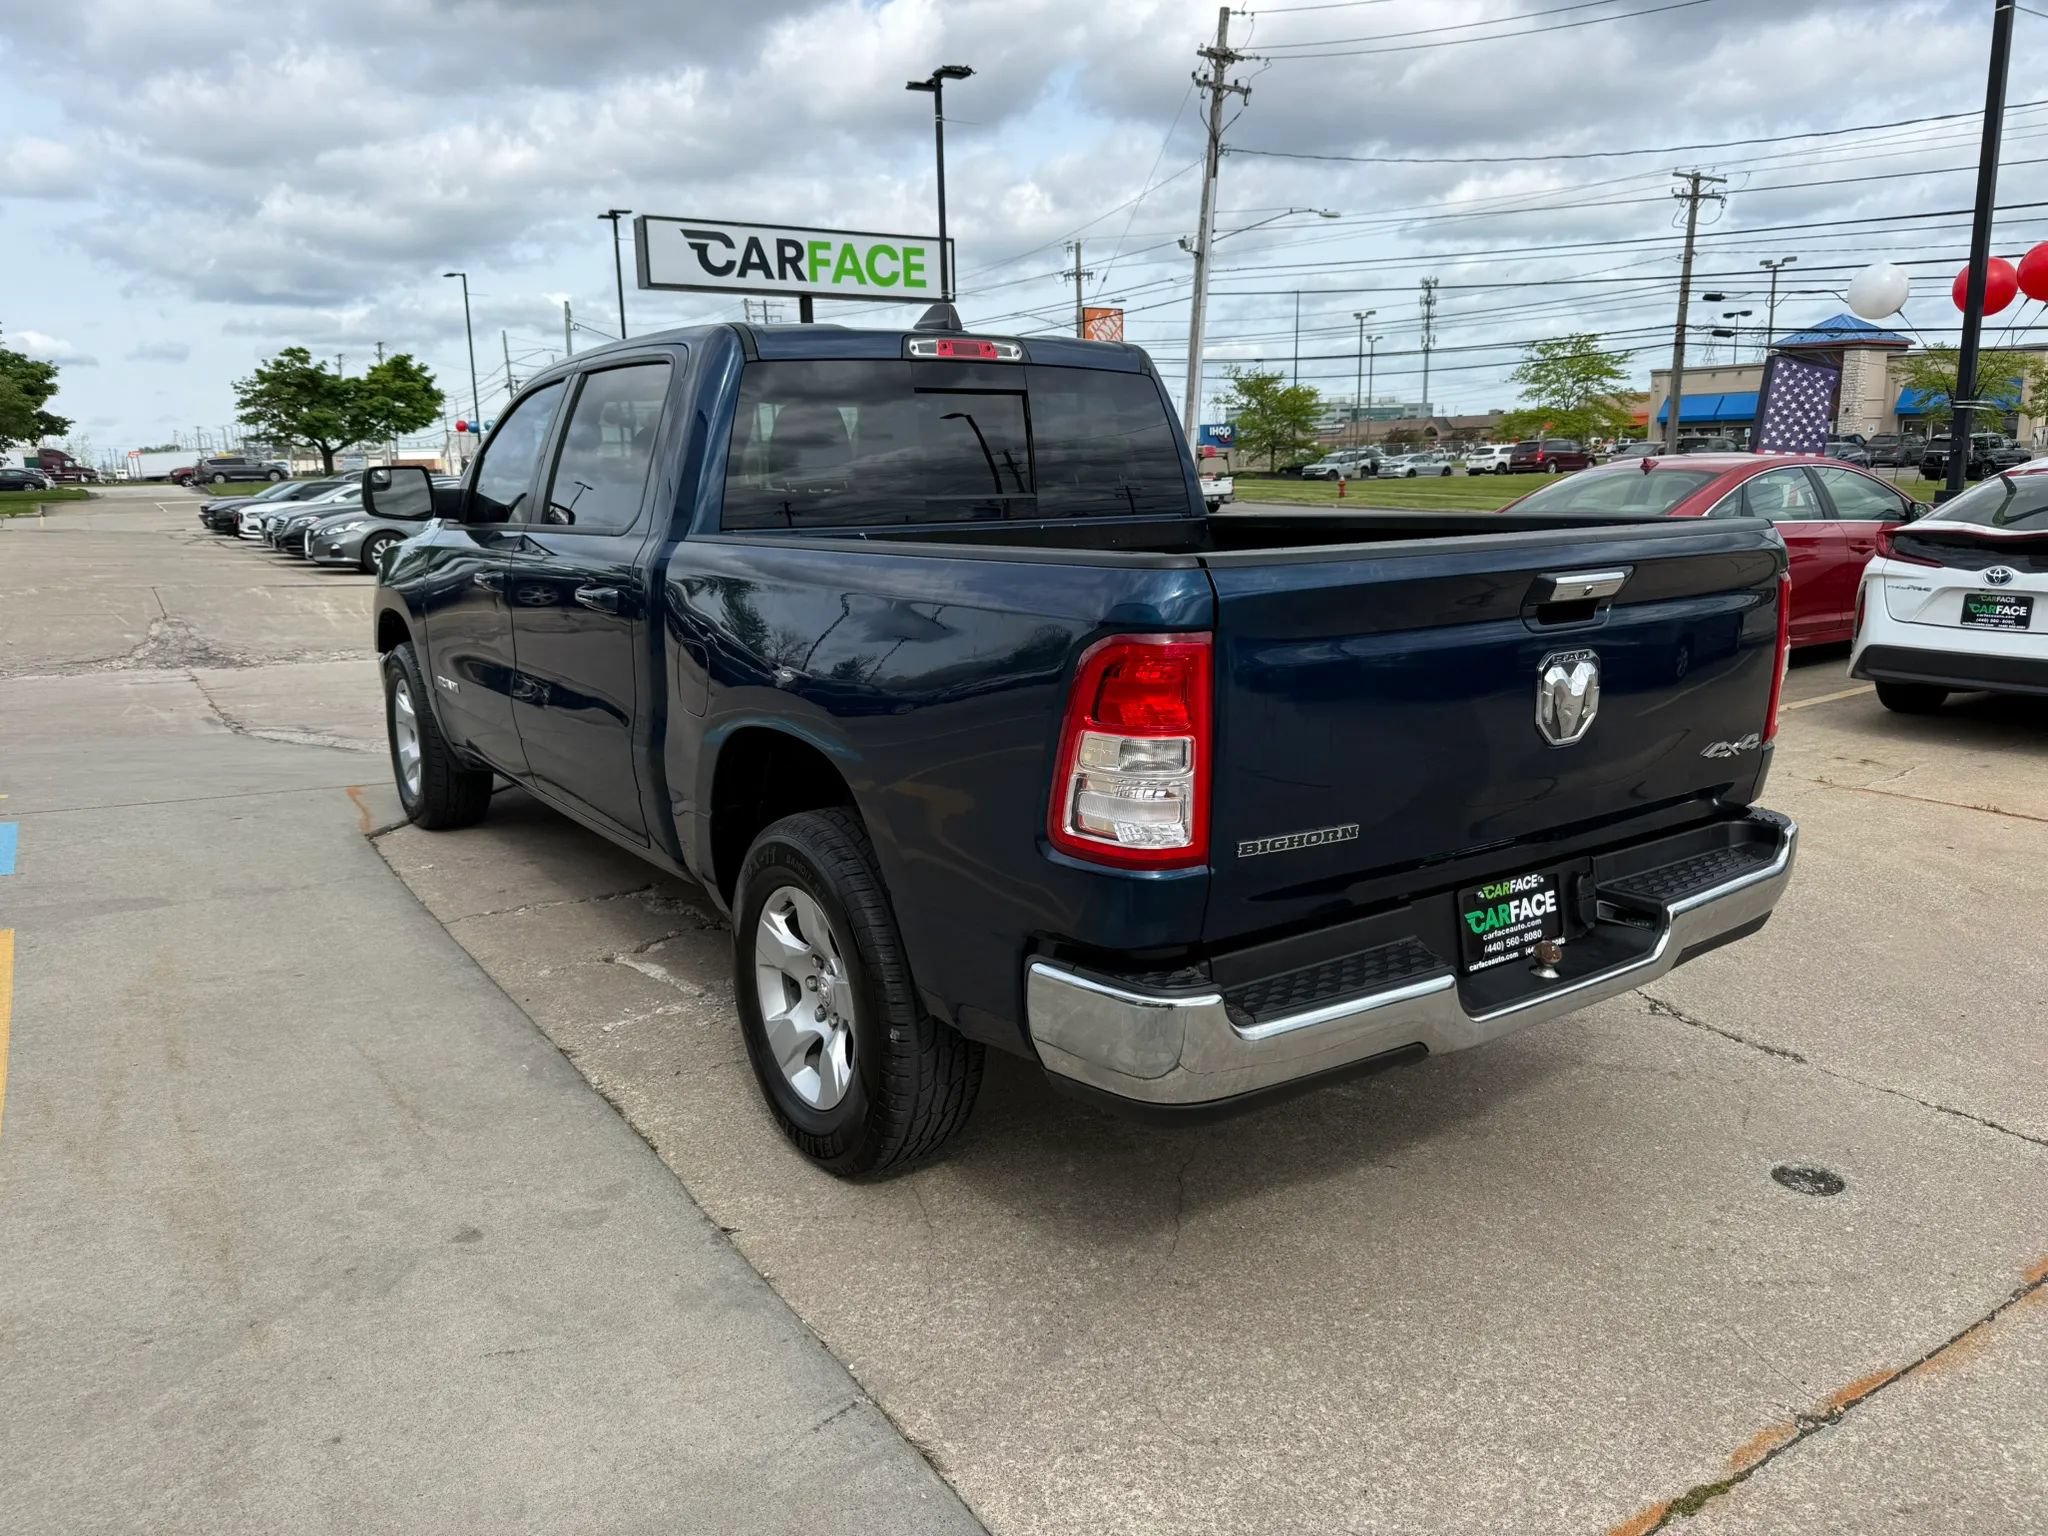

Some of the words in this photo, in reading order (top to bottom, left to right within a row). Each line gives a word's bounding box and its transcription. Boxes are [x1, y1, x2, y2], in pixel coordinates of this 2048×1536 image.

[680, 228, 927, 288] CARFACE
[1968, 603, 2028, 616] CARFACE
[1553, 650, 1591, 662] RAM
[1237, 824, 1360, 857] BIGHORN
[1483, 874, 1538, 899] CARFACE
[1464, 890, 1557, 934] CARFACE
[1483, 919, 1542, 940] carfaceauto.com
[1485, 940, 1505, 953] (440)
[1469, 951, 1519, 972] carfaceauto.com
